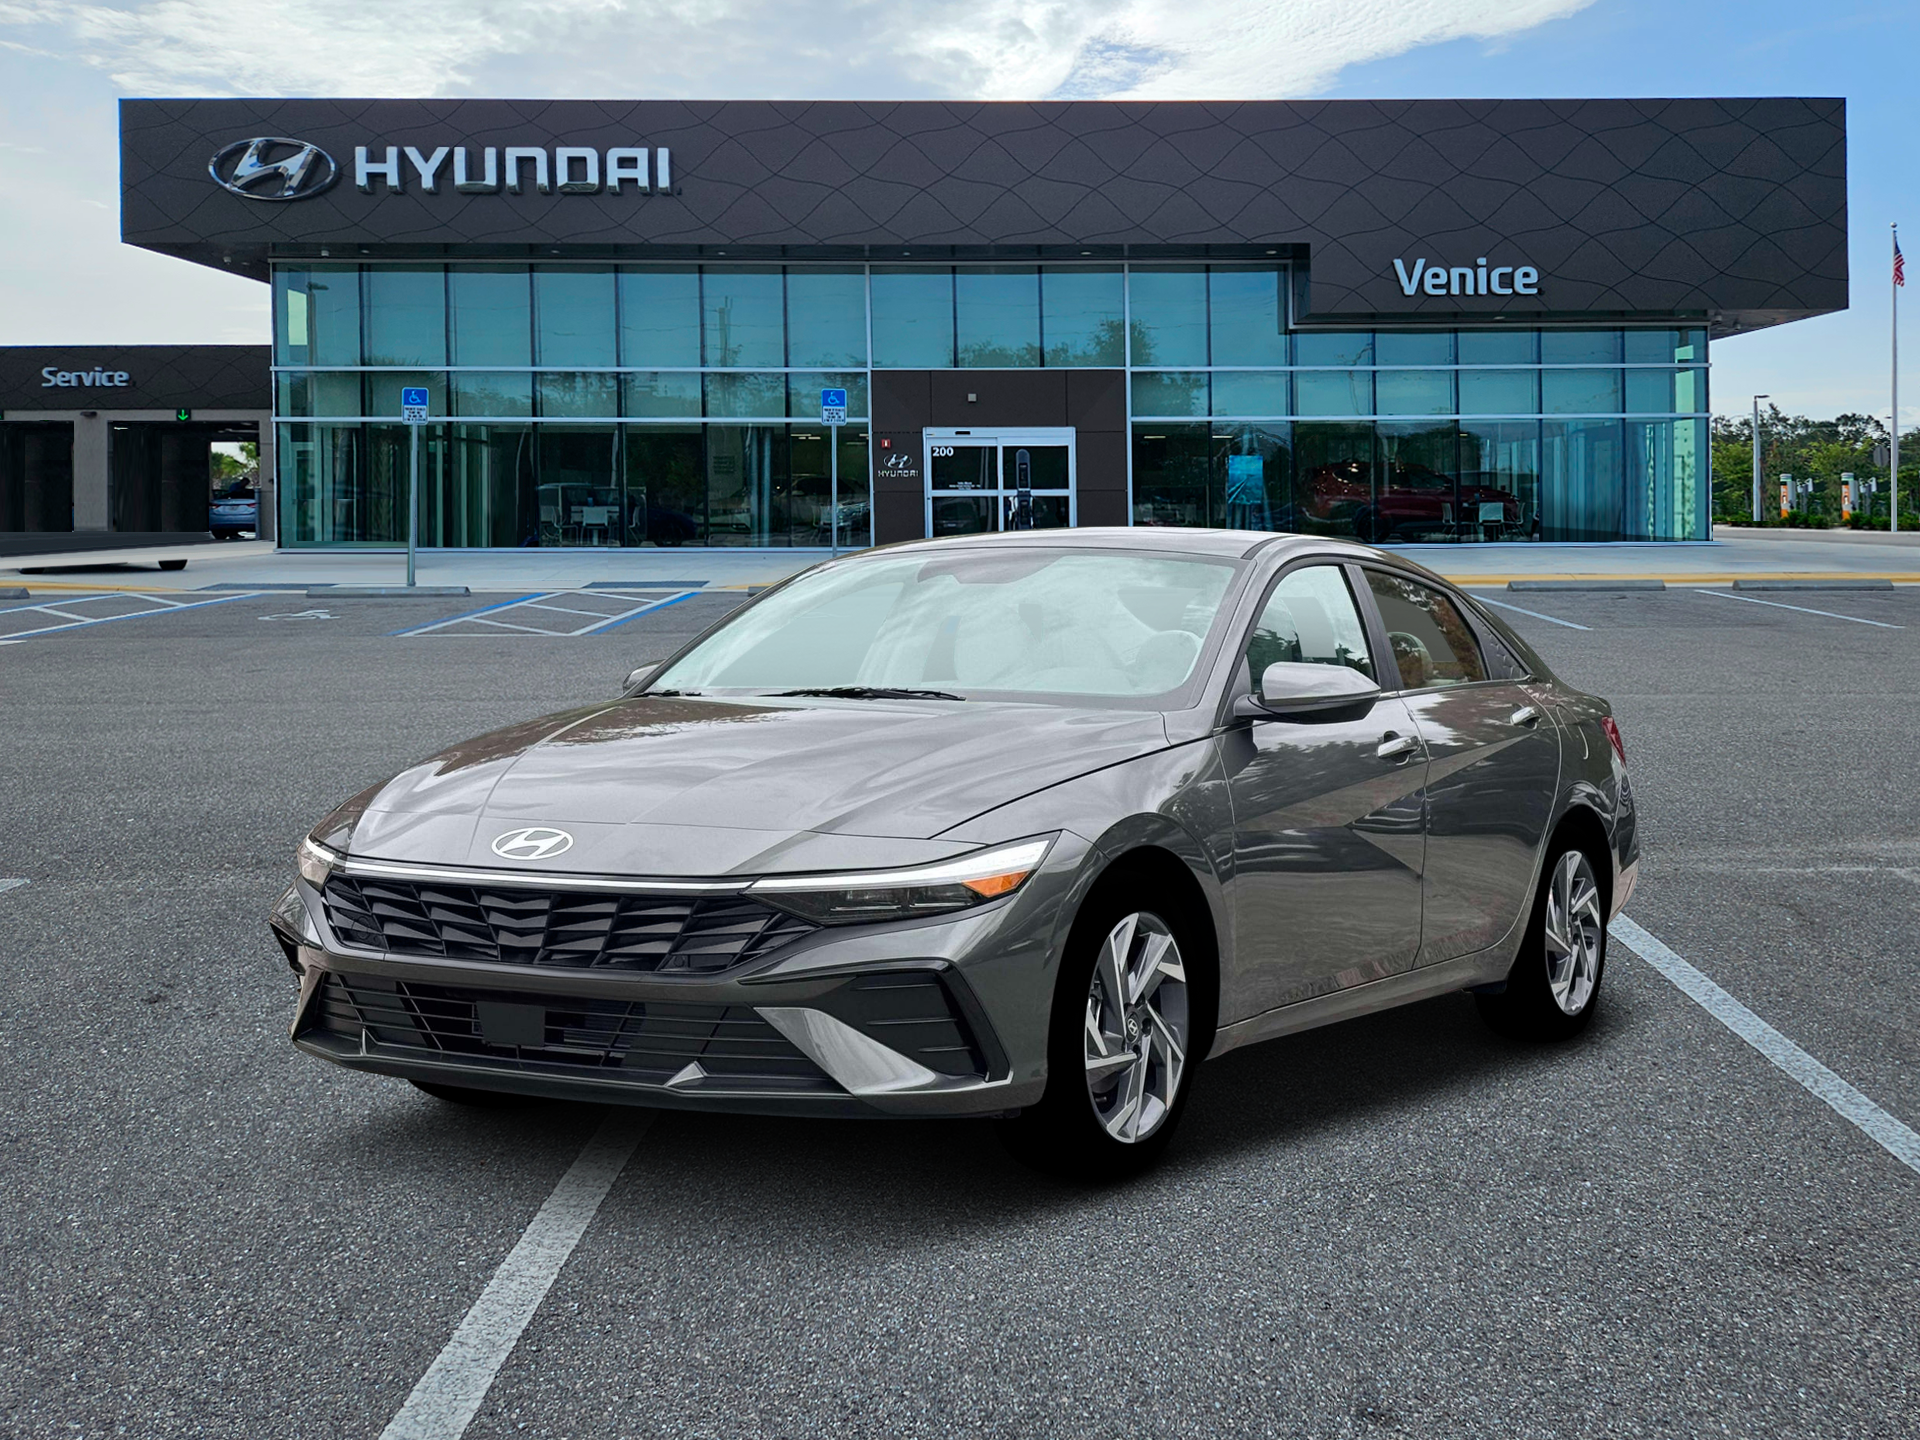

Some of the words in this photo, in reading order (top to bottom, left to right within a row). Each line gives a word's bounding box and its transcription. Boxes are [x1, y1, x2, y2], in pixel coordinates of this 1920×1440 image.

[355, 147, 670, 194] HYUNDAI
[1393, 257, 1538, 296] Venice
[41, 366, 130, 387] Service
[932, 446, 954, 456] 200
[878, 469, 919, 477] HYUNDAI
